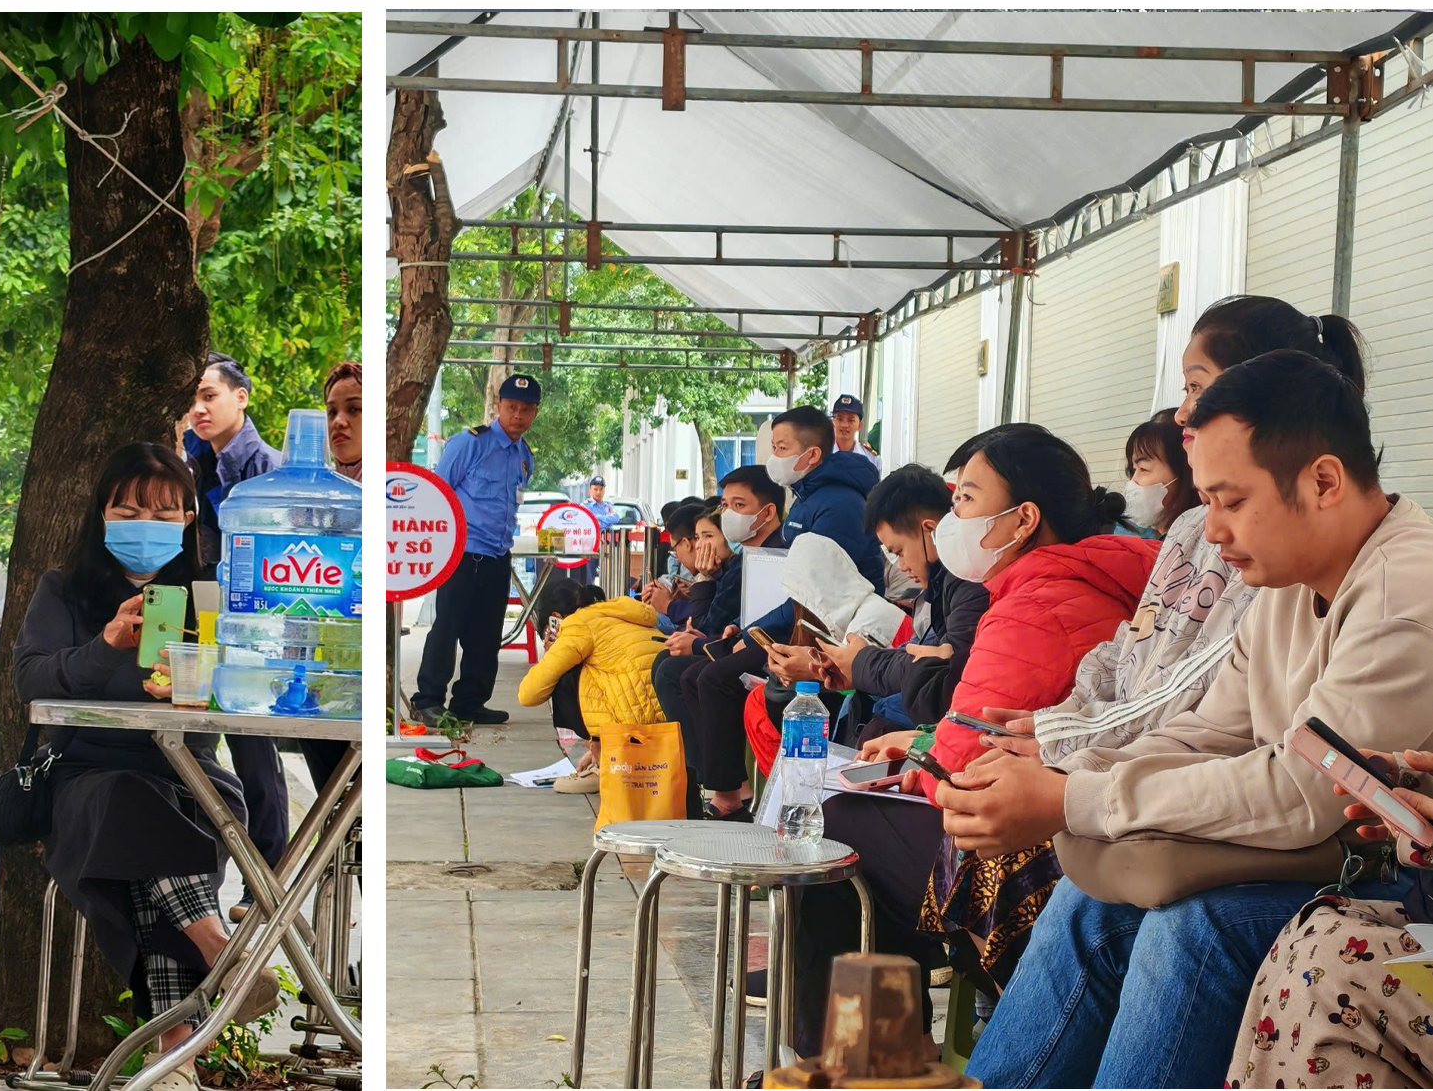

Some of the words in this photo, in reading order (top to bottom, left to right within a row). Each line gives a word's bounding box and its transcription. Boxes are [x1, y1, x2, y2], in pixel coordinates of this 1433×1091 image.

[392, 516, 448, 533] HÀNG
[405, 536, 433, 555] SỐ
[262, 555, 342, 585] laVie
[407, 560, 434, 579] TỰ
